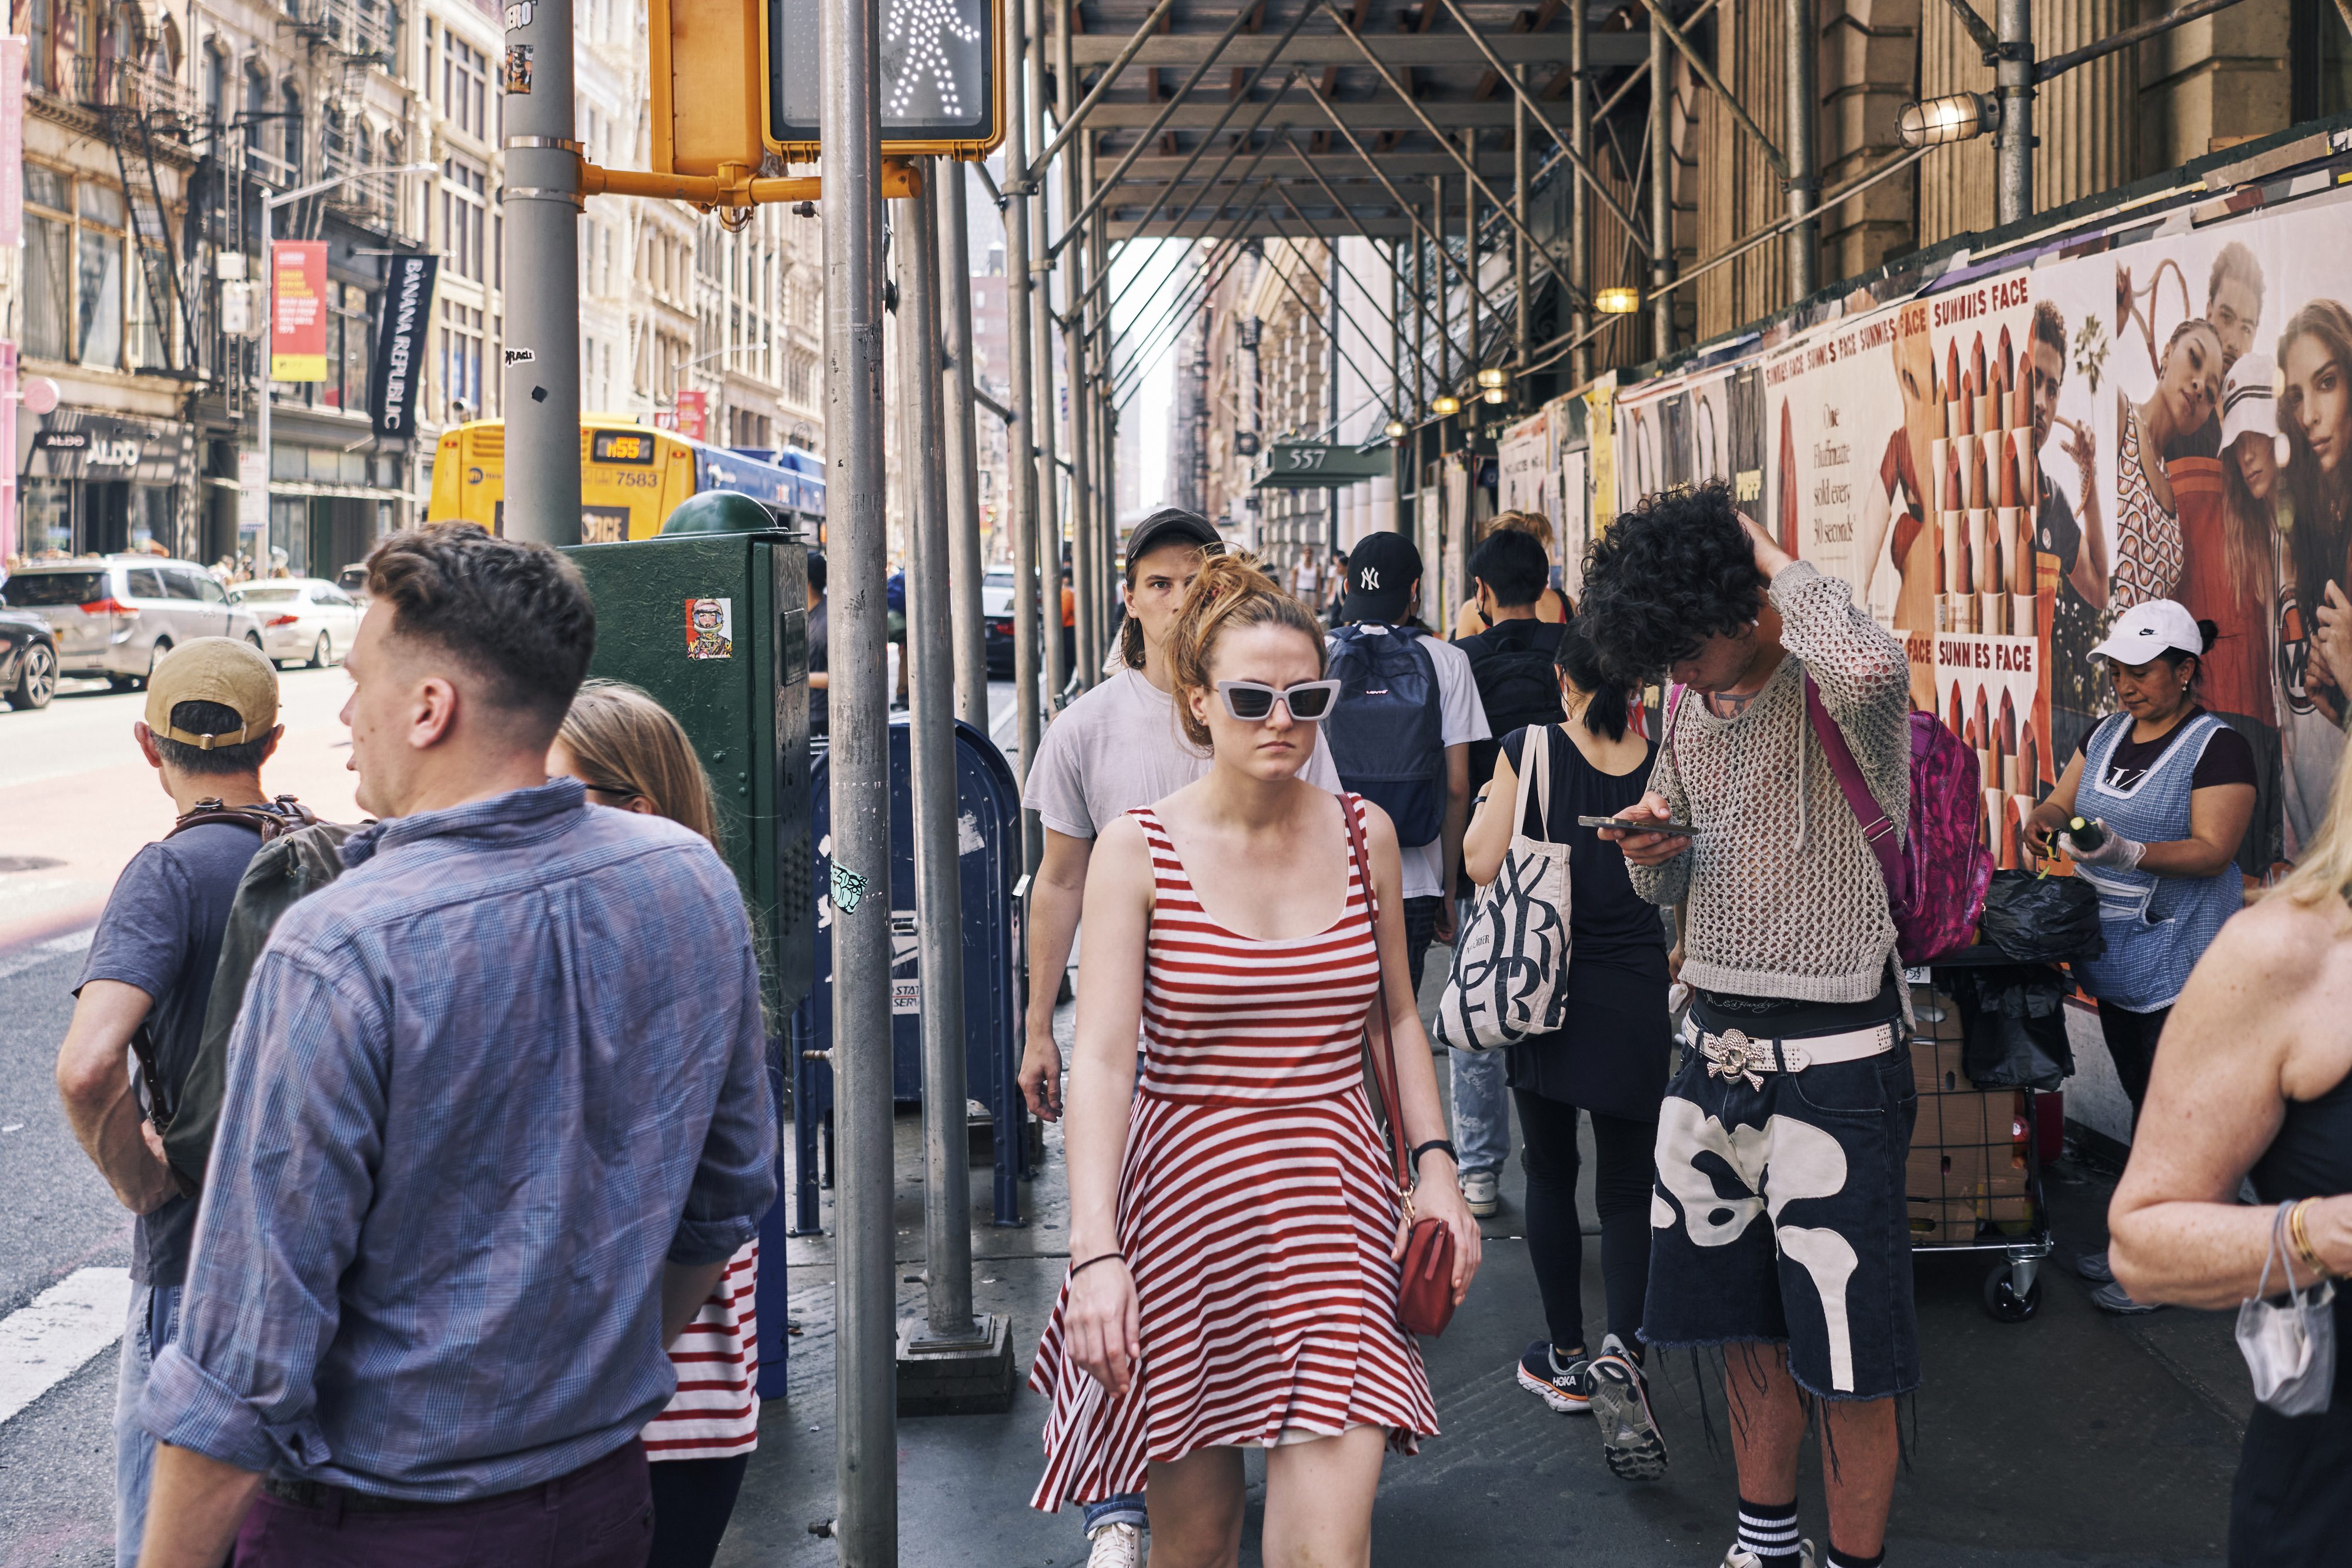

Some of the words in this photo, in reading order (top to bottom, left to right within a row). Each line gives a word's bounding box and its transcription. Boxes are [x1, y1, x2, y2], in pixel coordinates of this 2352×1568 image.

[506, 1, 533, 31] ERO
[396, 259, 423, 335] BANANA
[1935, 289, 1987, 327] SUNNIES
[1992, 276, 2029, 312] FACE
[1860, 318, 1897, 352] SUNNIES
[1899, 307, 1927, 337] FACE
[384, 336, 411, 430] REPUBLIC
[46, 435, 85, 447] ALDO
[86, 435, 140, 466] ALDO
[606, 437, 640, 459] M55
[1289, 449, 1327, 469] 557
[617, 472, 657, 487] 7583
[1815, 479, 1829, 507] sold
[1361, 567, 1380, 590] NY
[1907, 638, 1932, 665] FACE
[1939, 641, 1991, 670] SUNNIES
[1996, 644, 2032, 673] FACE
[1552, 1375, 1576, 1387] HOKA
